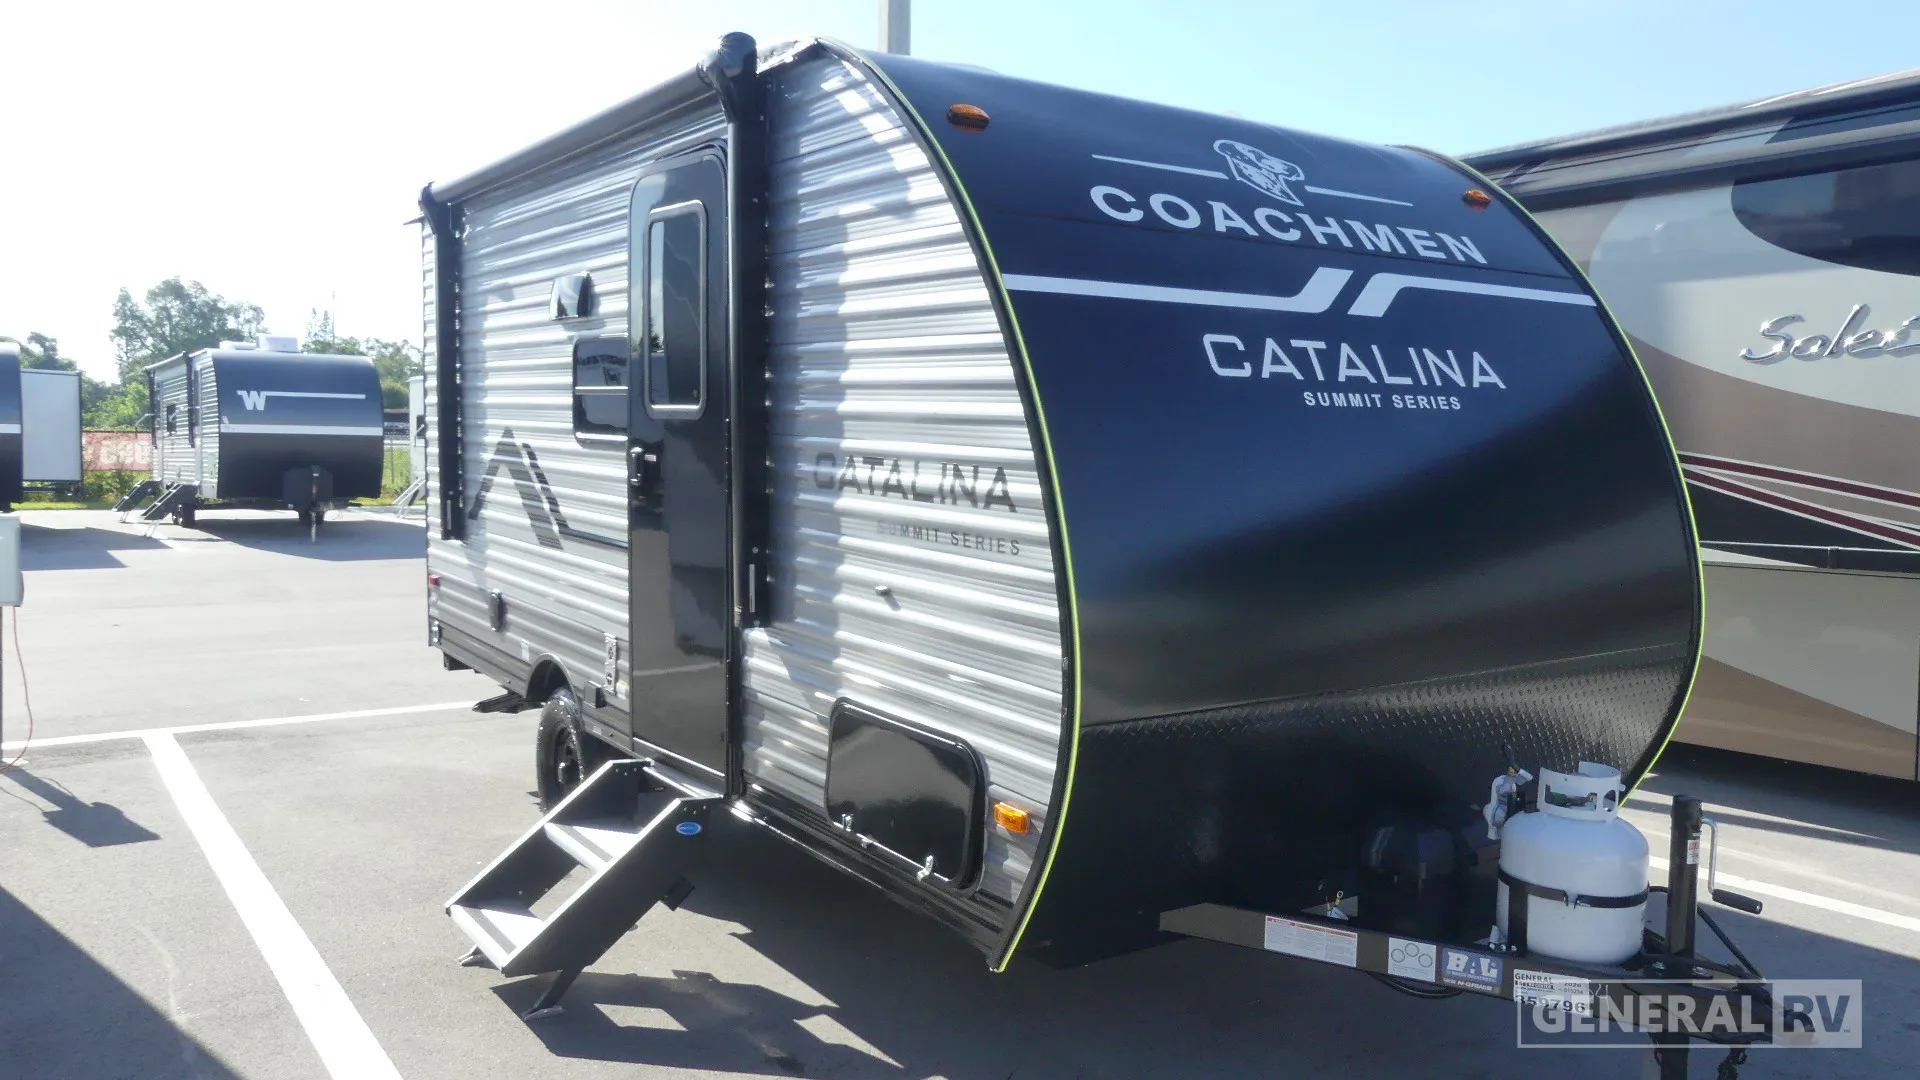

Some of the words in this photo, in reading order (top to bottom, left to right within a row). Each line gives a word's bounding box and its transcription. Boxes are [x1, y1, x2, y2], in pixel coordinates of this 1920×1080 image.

[1089, 185, 1487, 264] COACHMEN
[1202, 333, 1506, 389] CATALINA
[1303, 391, 1381, 409] SUMMIT
[1393, 394, 1461, 410] SERIES
[814, 452, 1017, 513] CATALINA
[950, 531, 1021, 556] SERIES
[1515, 973, 1554, 984] GENERAL
